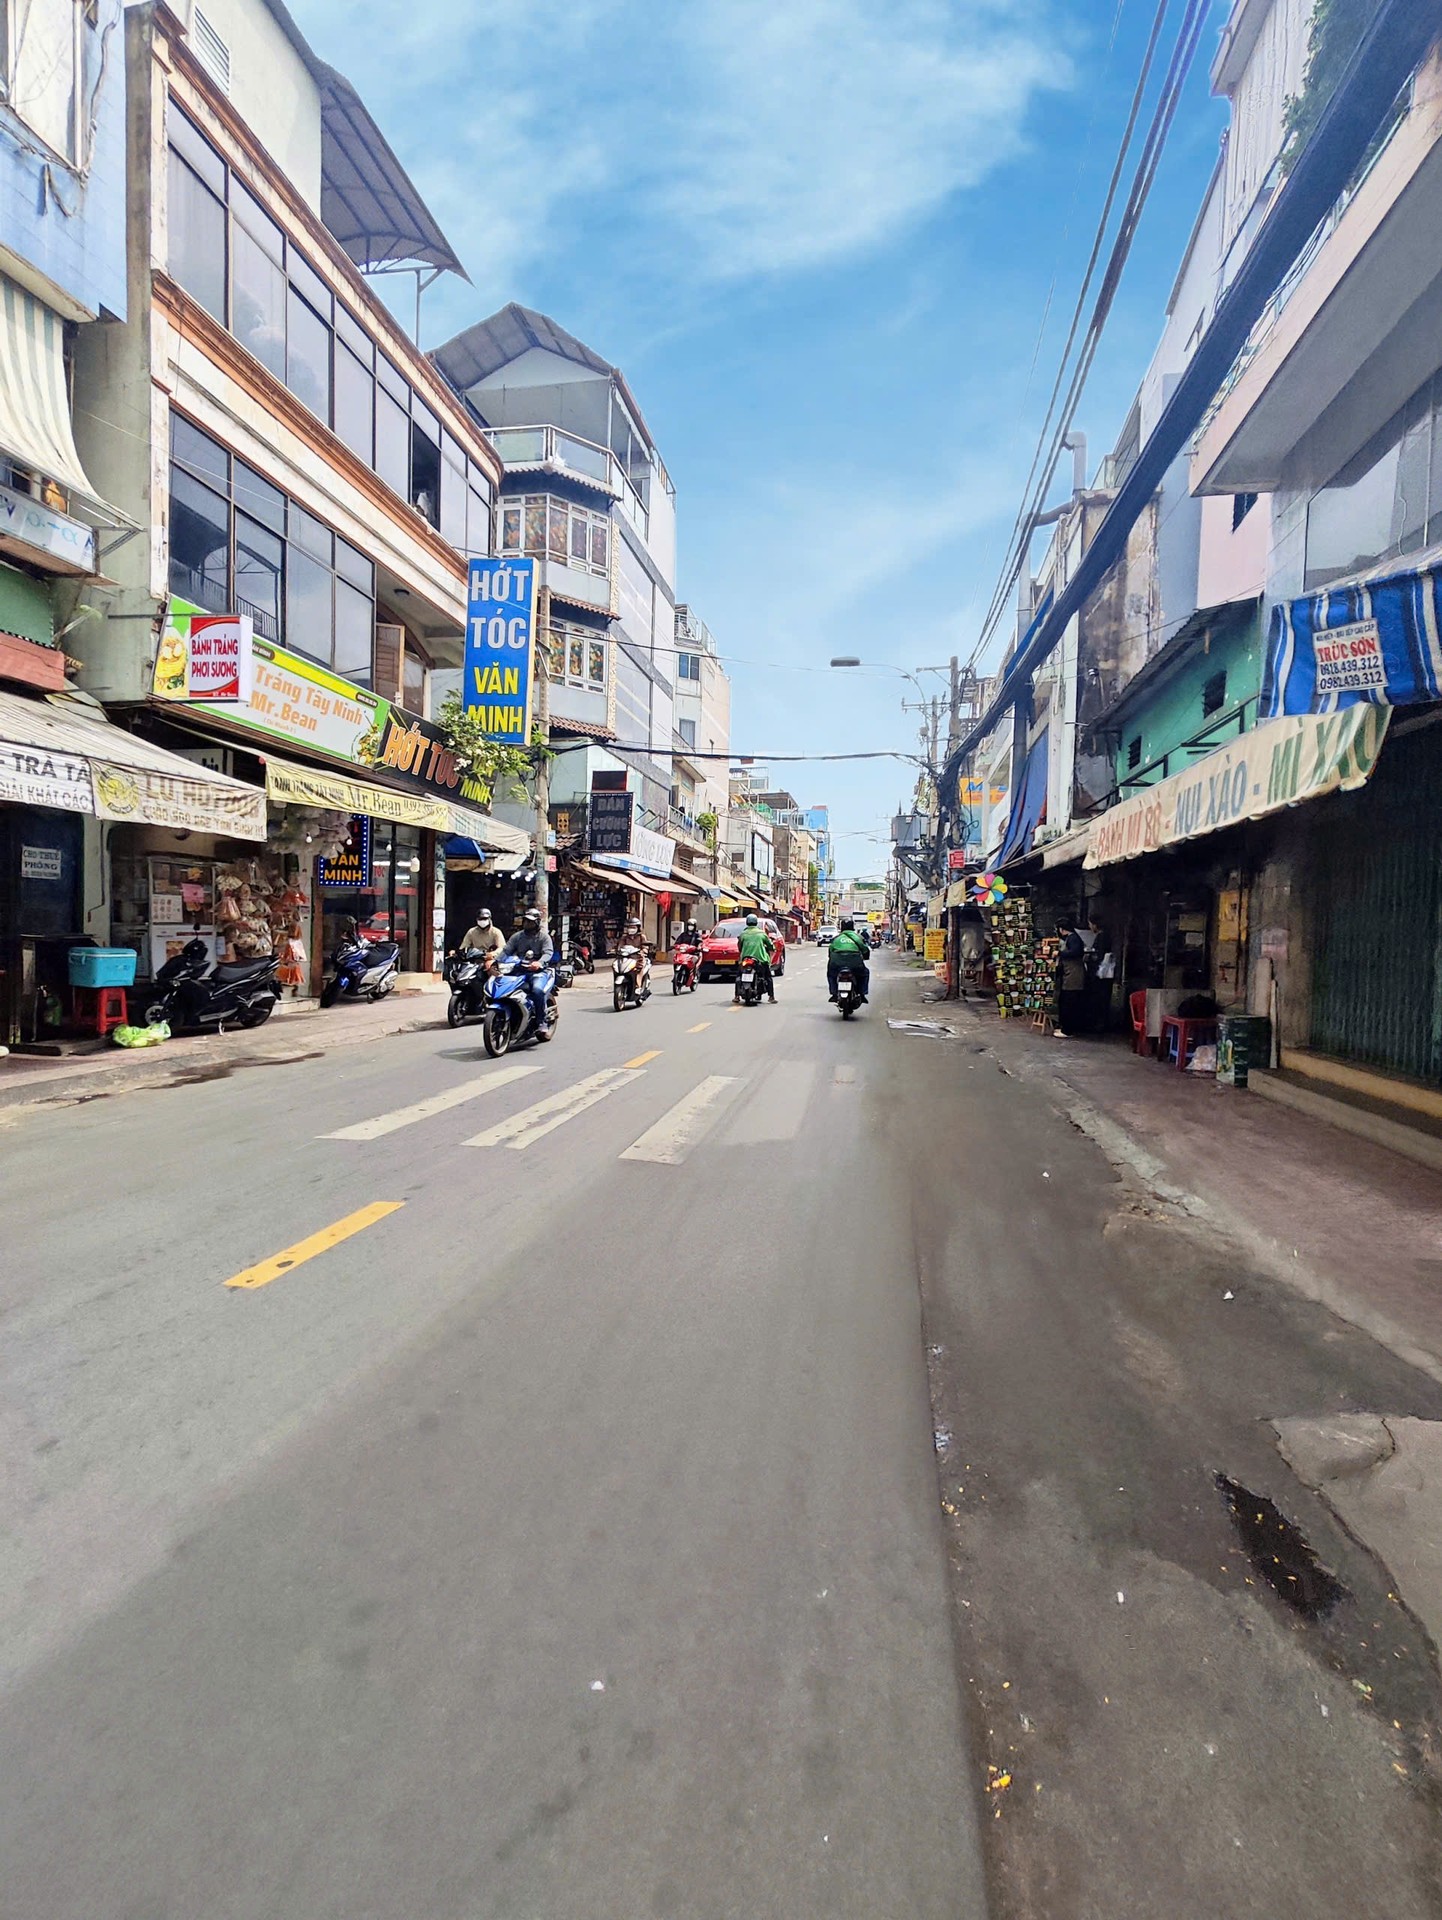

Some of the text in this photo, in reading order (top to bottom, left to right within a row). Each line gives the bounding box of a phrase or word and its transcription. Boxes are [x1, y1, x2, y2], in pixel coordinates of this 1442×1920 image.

[471, 562, 529, 601] HỚT
[470, 608, 526, 649] TÓC
[1317, 636, 1377, 663] TRÚC SƠN
[191, 661, 237, 677] PHƠI SƯƠNG
[474, 662, 518, 695] VĂN
[1320, 655, 1380, 676] 0918.439.312
[256, 664, 302, 704] Tráng
[306, 686, 331, 716] Tây
[333, 699, 363, 726] Ninh
[467, 704, 523, 733] MINH
[382, 720, 431, 776] HỚT
[12, 752, 57, 778] TRÀ
[1173, 781, 1203, 835] NUI
[1205, 754, 1248, 826] XÀO
[1267, 716, 1304, 806] MÌ
[27, 784, 59, 805] KHÁT
[62, 786, 89, 810] CÁC
[592, 815, 628, 831] CƯỜNG
[596, 832, 622, 849] LỰC
[24, 860, 58, 870] PHÒNG
[324, 869, 362, 881] MINH
